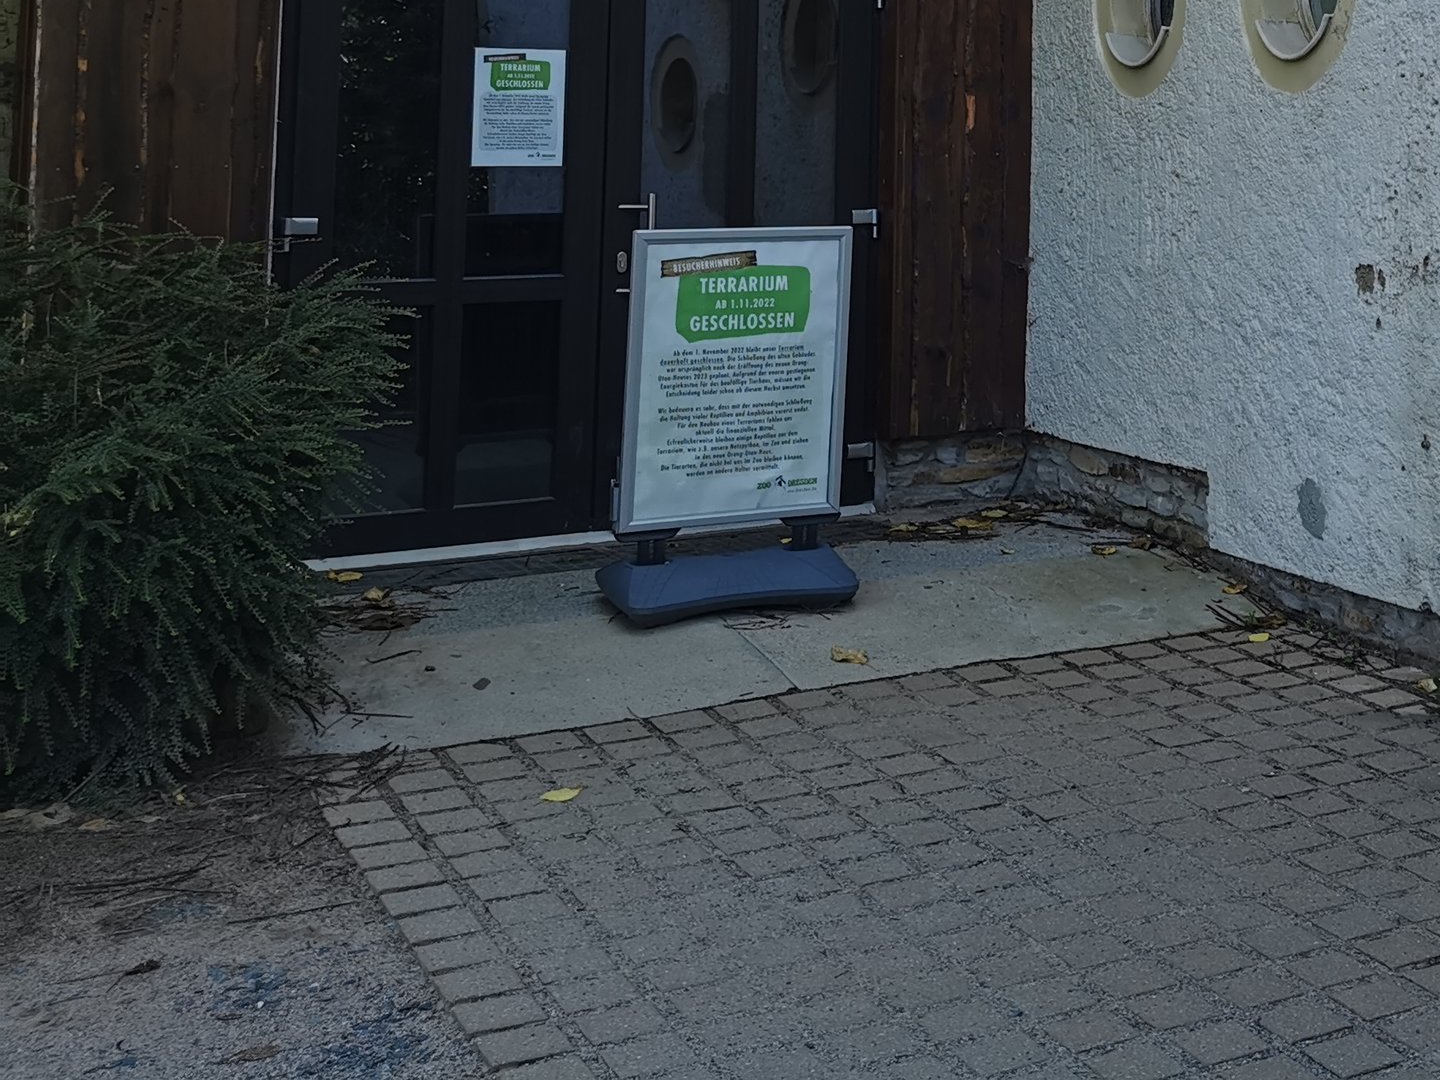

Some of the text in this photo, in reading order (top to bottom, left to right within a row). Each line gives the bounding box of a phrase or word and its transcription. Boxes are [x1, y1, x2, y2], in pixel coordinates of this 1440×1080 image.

[501, 64, 541, 72] TERRARIUM
[496, 80, 544, 88] GESCHLOSSEN
[673, 256, 741, 273] BESUCHERHINWEIS
[700, 275, 788, 293] TERRARIUM
[715, 298, 775, 309] AB 1.11.2022
[690, 312, 794, 332] GESCHLOSSEN
